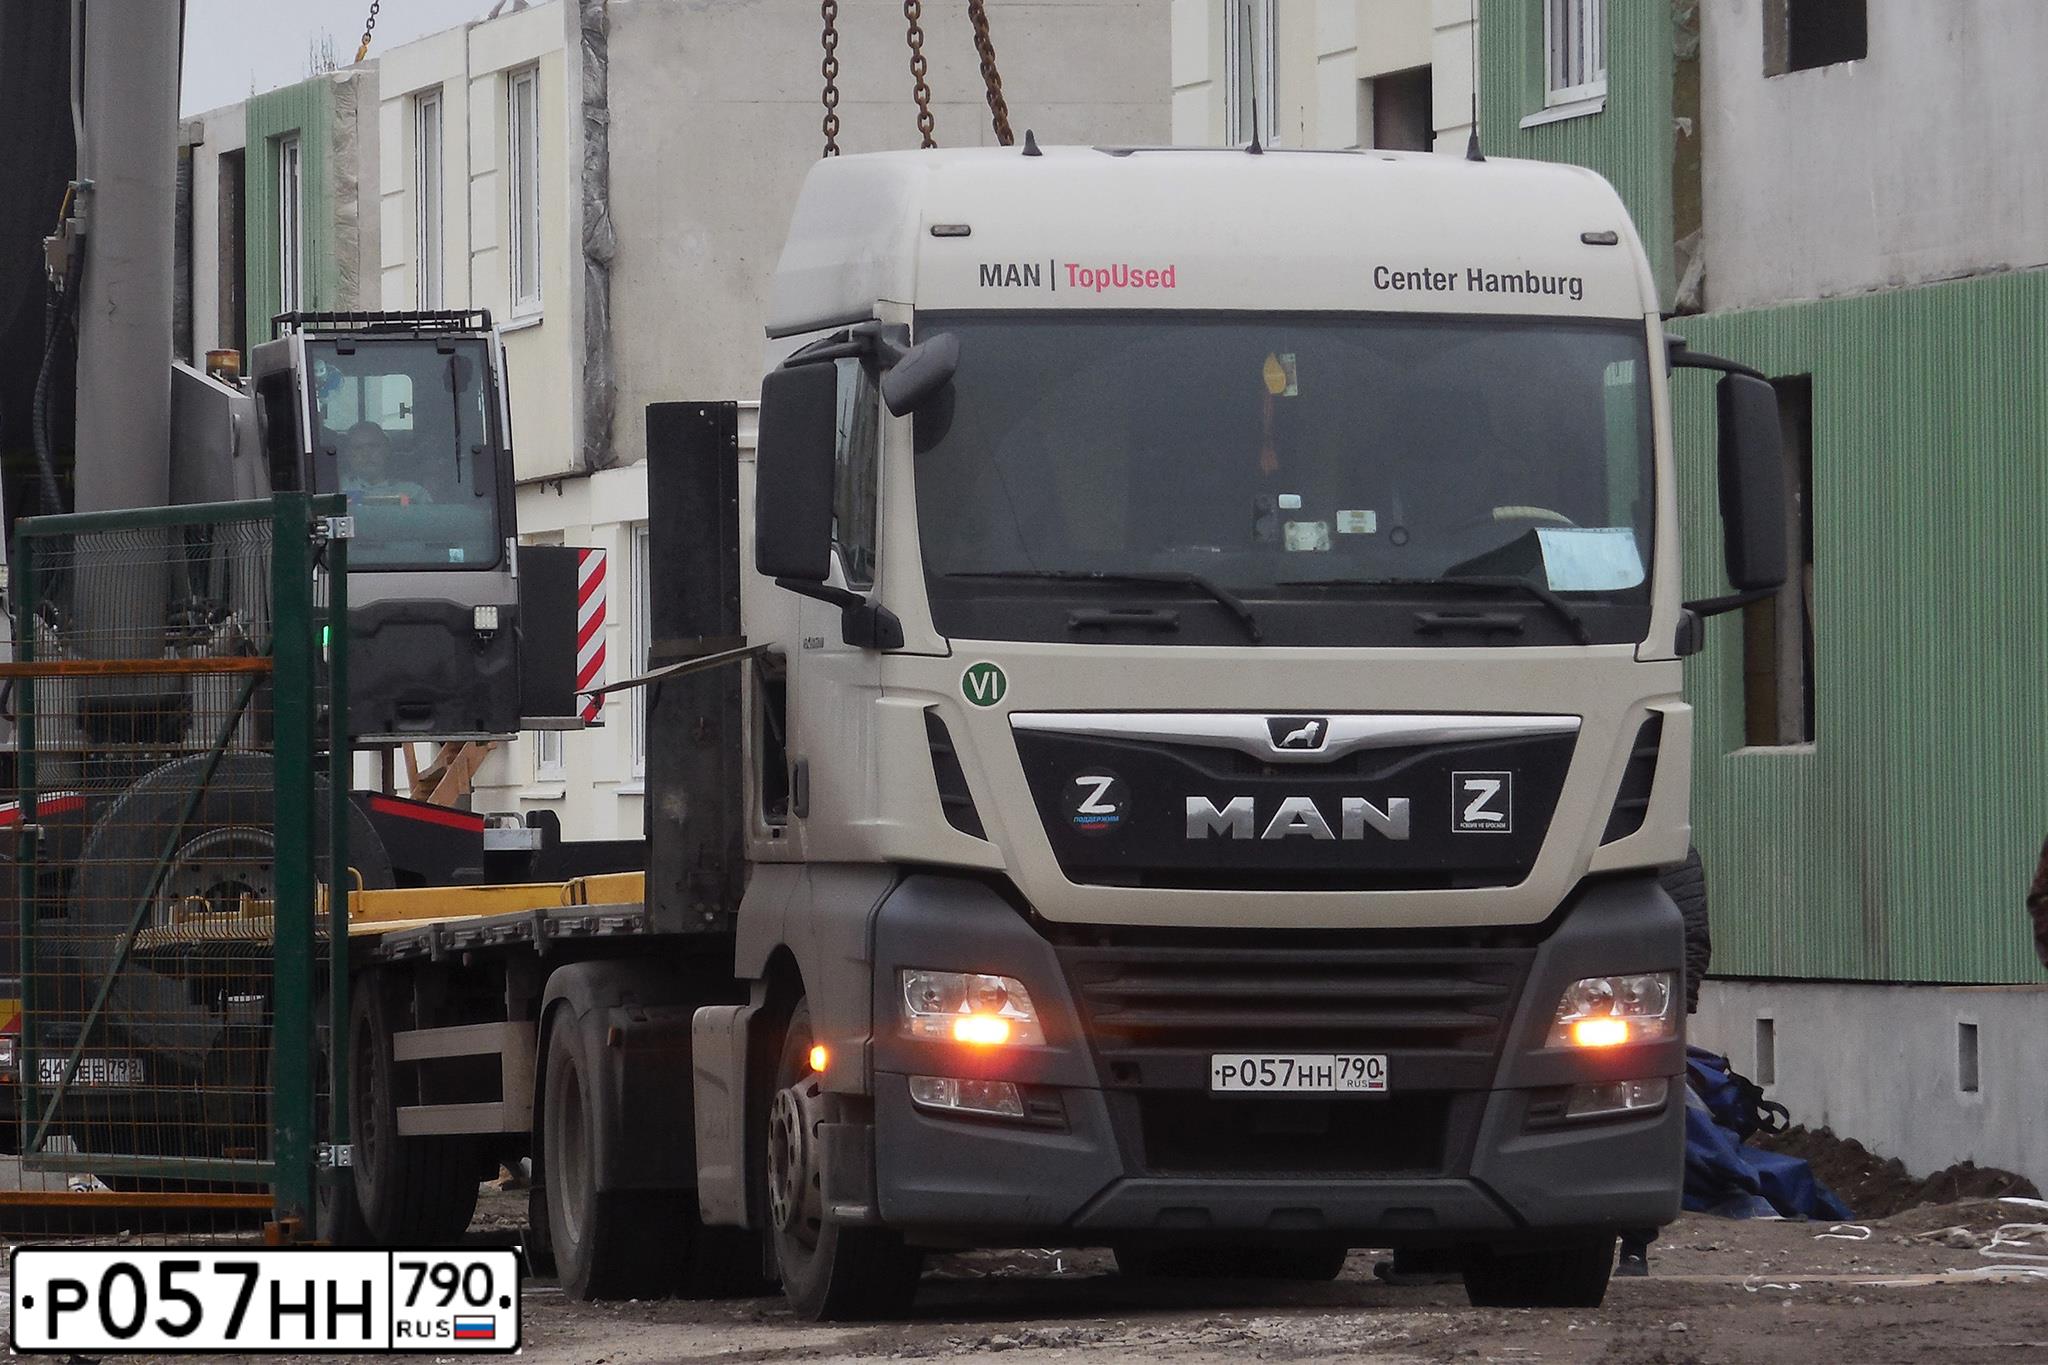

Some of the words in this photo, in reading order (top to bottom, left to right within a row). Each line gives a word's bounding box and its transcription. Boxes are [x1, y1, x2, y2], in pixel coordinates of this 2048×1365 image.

[979, 263, 1041, 287] MAN
[1064, 263, 1176, 293] TopUsed
[1373, 265, 1458, 291] Center
[1466, 267, 1584, 301] Hamburg
[968, 671, 998, 700] VI
[1075, 775, 1116, 814] Z
[1463, 779, 1504, 822] Z
[1185, 796, 1410, 840] MAN
[1337, 1057, 1380, 1079] 790
[1347, 1079, 1368, 1088] RUS
